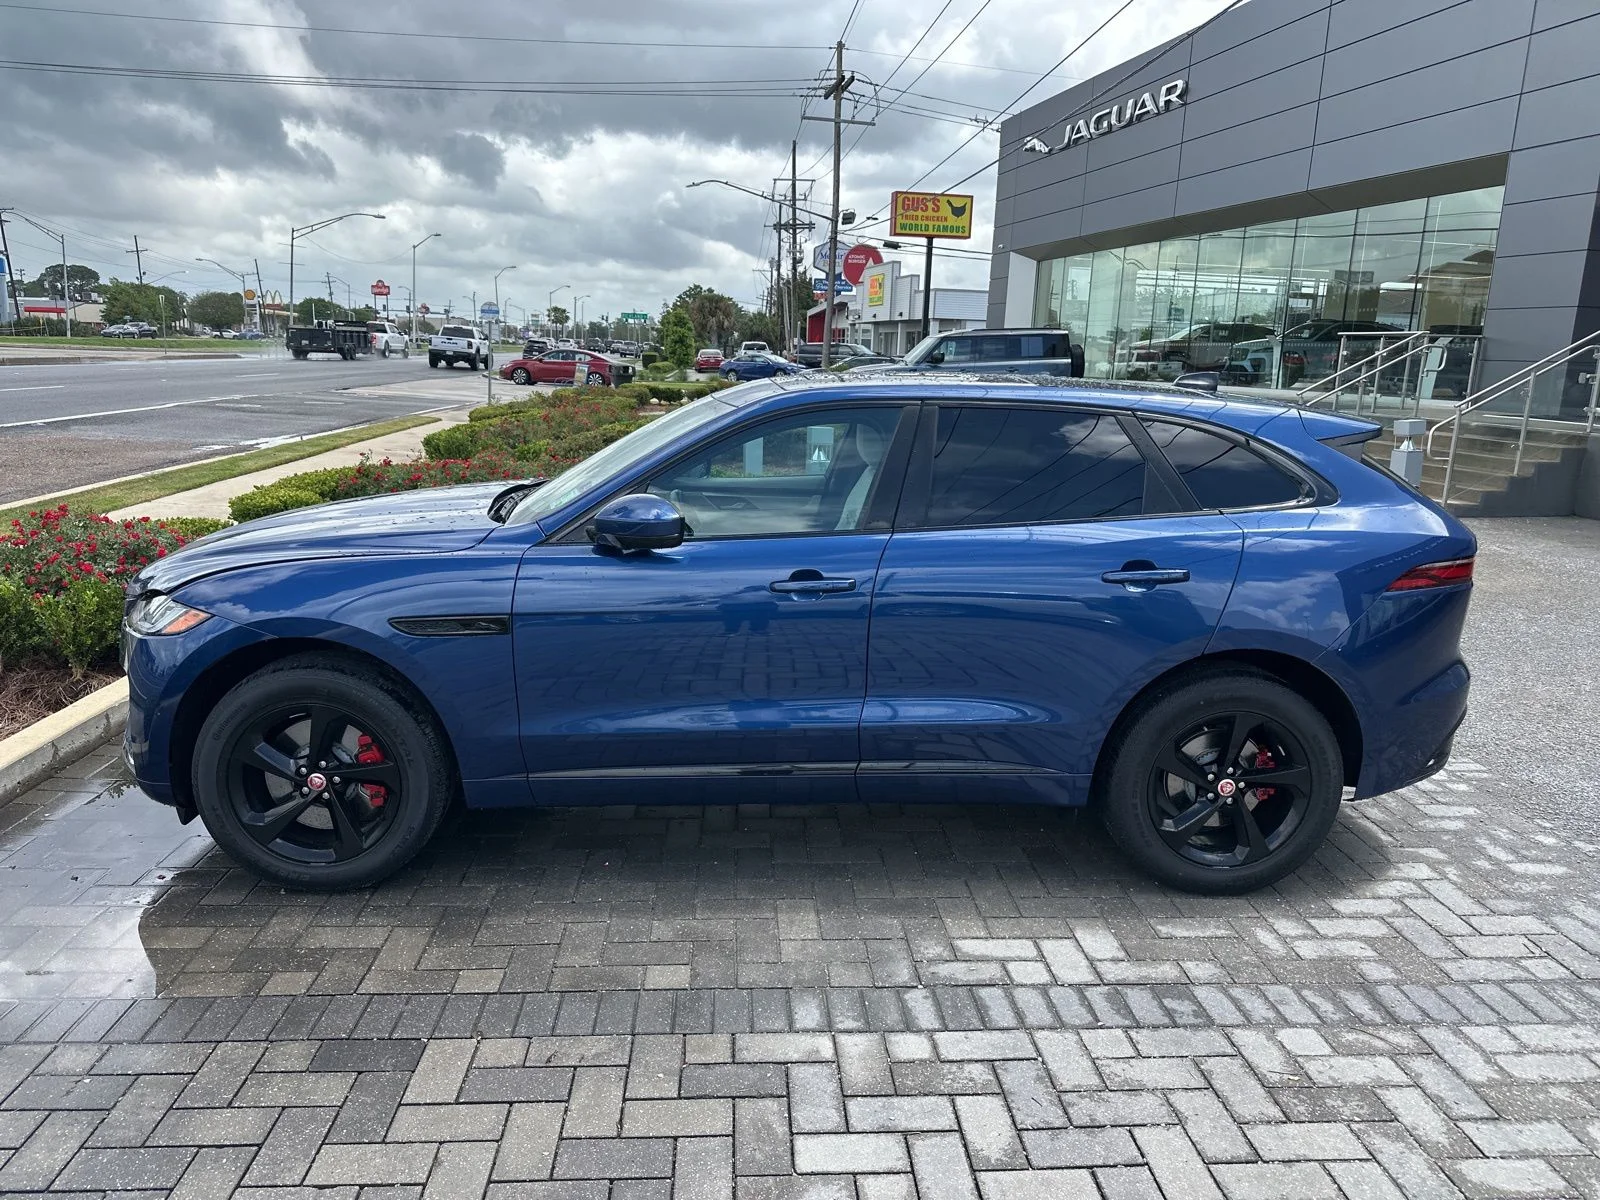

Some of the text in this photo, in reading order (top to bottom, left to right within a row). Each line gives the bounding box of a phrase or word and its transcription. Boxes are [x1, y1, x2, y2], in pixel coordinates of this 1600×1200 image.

[1054, 79, 1188, 151] JAGUAR
[901, 196, 941, 213] GUS'S
[901, 213, 948, 223] FRIED CHICKEN
[899, 222, 966, 234] WORLD FAMOUS
